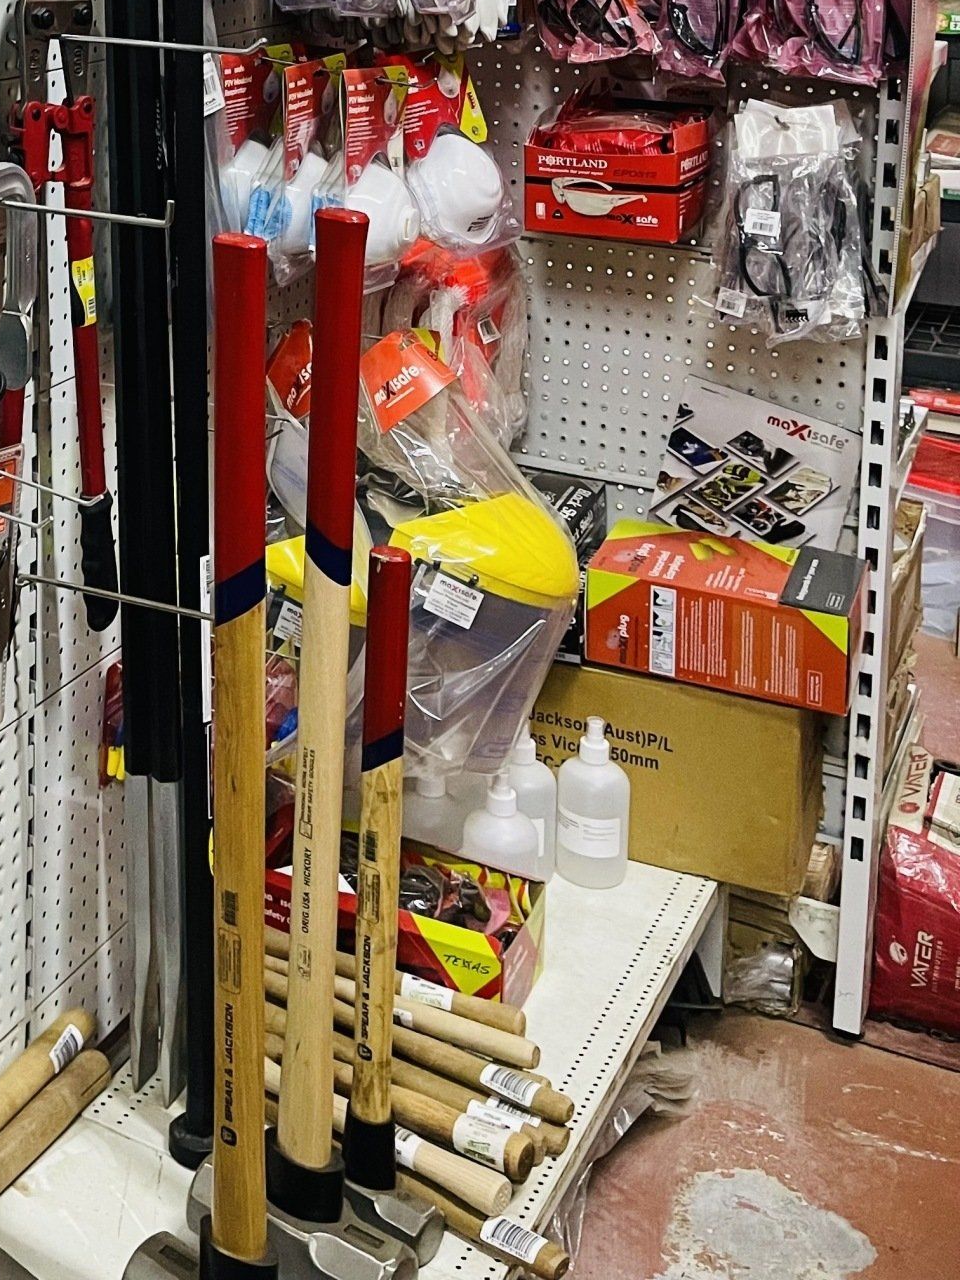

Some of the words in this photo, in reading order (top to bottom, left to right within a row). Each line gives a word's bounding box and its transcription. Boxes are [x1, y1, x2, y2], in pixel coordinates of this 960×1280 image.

[537, 154, 608, 169] PORTLAND
[603, 722, 674, 753] Aust)P/L
[609, 746, 660, 770] 50mm
[901, 752, 929, 802] VATER
[303, 847, 313, 887] HICKORY
[265, 907, 285, 923] afety
[303, 891, 311, 909] USA
[301, 909, 310, 934] ORIG
[362, 934, 371, 989] JACKSON
[909, 930, 935, 989] VATER
[224, 1003, 234, 1064] JACKSON
[360, 1004, 370, 1041] SPEAR
[223, 1080, 234, 1123] SPEAR
